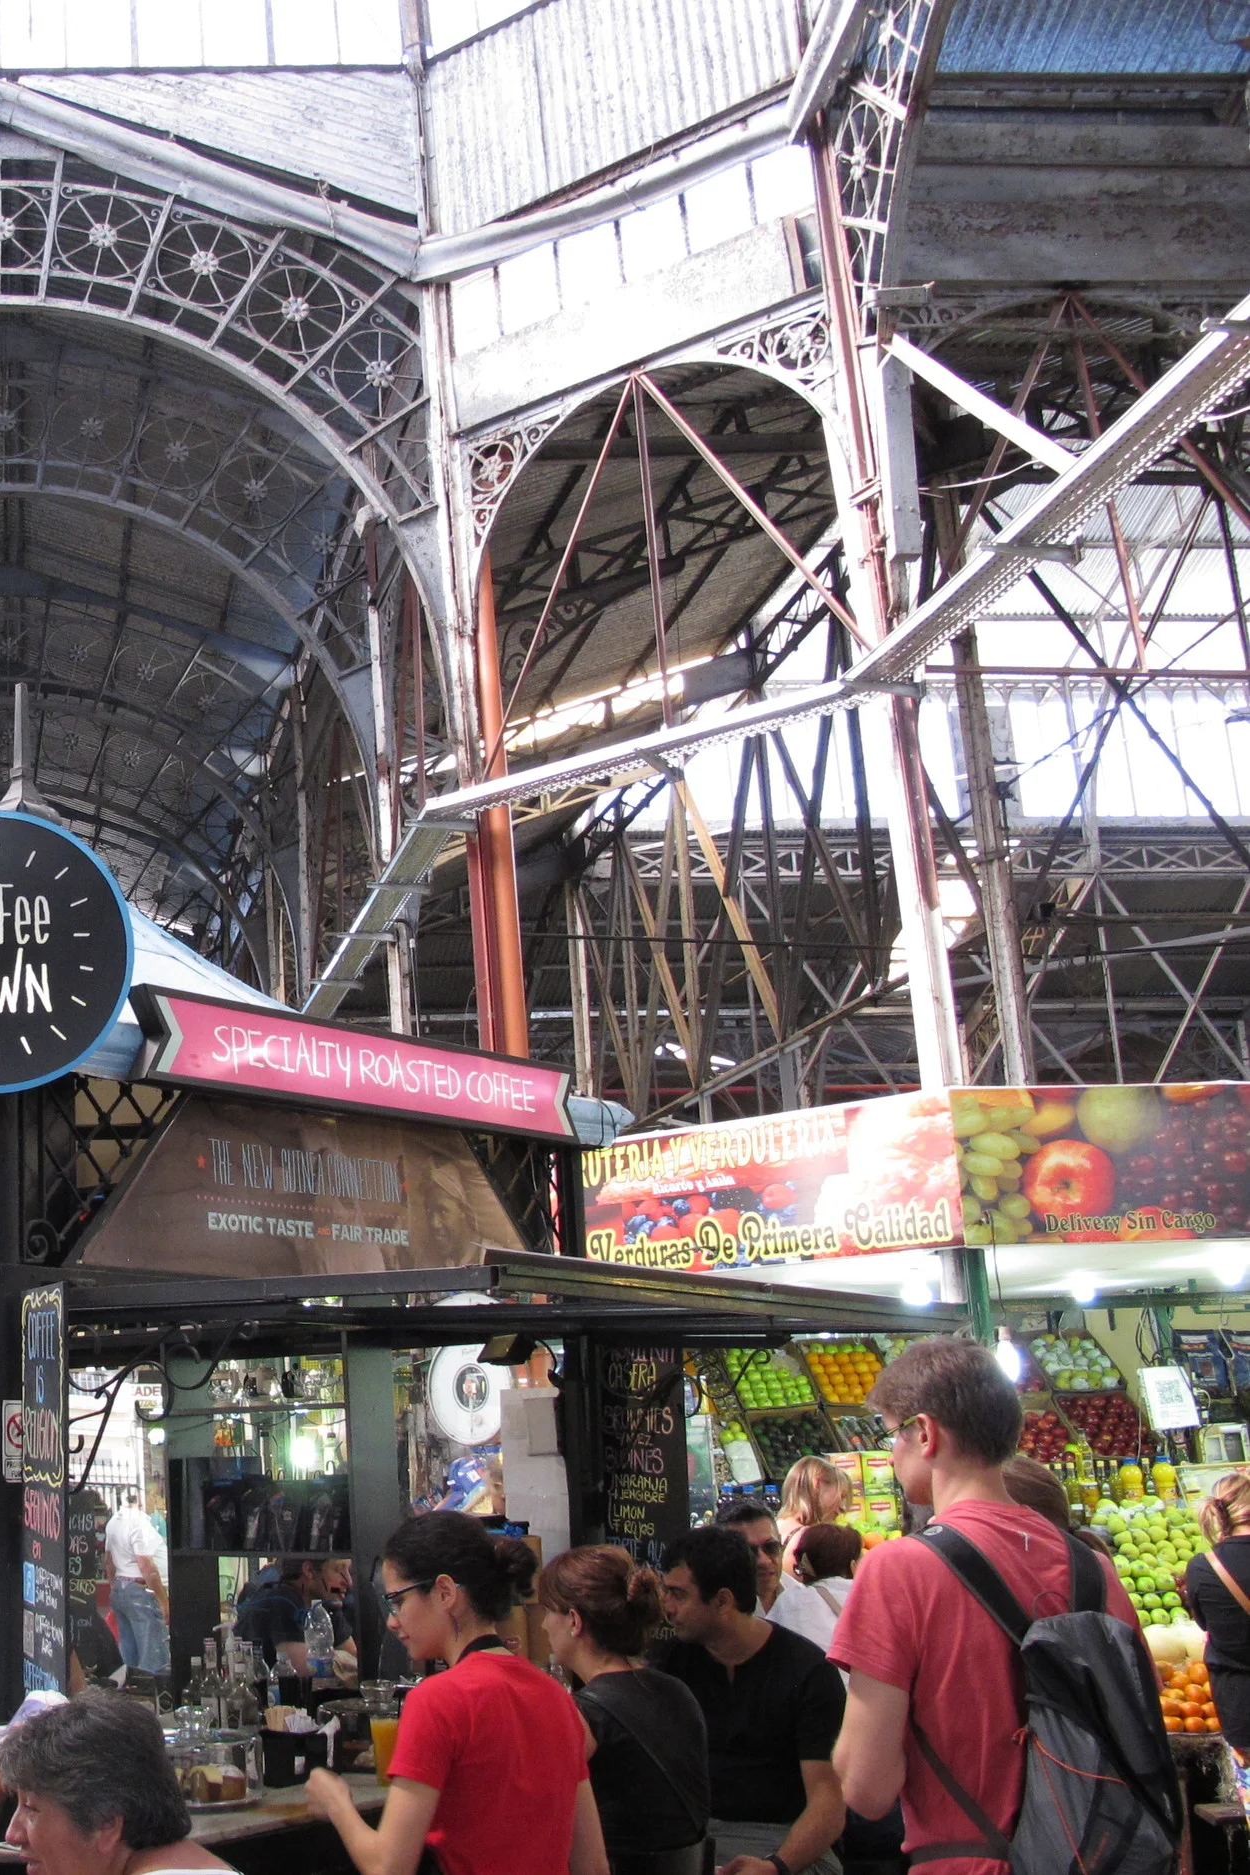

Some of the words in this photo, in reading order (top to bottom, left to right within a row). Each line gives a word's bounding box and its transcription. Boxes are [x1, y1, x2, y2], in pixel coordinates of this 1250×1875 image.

[211, 1025, 351, 1088] SPECIALTY
[359, 1049, 461, 1100] ROASTED
[466, 1070, 536, 1113] COFFEE
[671, 1135, 685, 1174] Y
[689, 1114, 843, 1172] VERDULERIA
[208, 1138, 235, 1186] THE
[241, 1143, 273, 1189] NEW
[281, 1147, 326, 1195] GUINEA
[327, 1154, 400, 1203] CONNECTION
[651, 1176, 694, 1196] Ricardo
[207, 1211, 264, 1235] EXOTIC
[265, 1217, 315, 1240] TASTE
[331, 1223, 363, 1243] FAIR
[365, 1226, 410, 1248] TRADE
[589, 1229, 694, 1269] Verduras
[695, 1216, 735, 1264] De
[738, 1211, 840, 1258] Primera
[843, 1197, 954, 1250] Calidad
[1044, 1213, 1122, 1234] Delivery
[1125, 1211, 1157, 1230] Sin
[1161, 1210, 1217, 1234] Cargo
[28, 1310, 56, 1361] COFFEE
[35, 1364, 45, 1404] IS
[608, 1361, 657, 1392] CASERA
[24, 1406, 59, 1466] RELIGION
[604, 1406, 674, 1435] BROWNIES
[605, 1447, 664, 1475] BUDINES
[612, 1473, 668, 1493] NARANJA
[613, 1503, 646, 1520] LIMON
